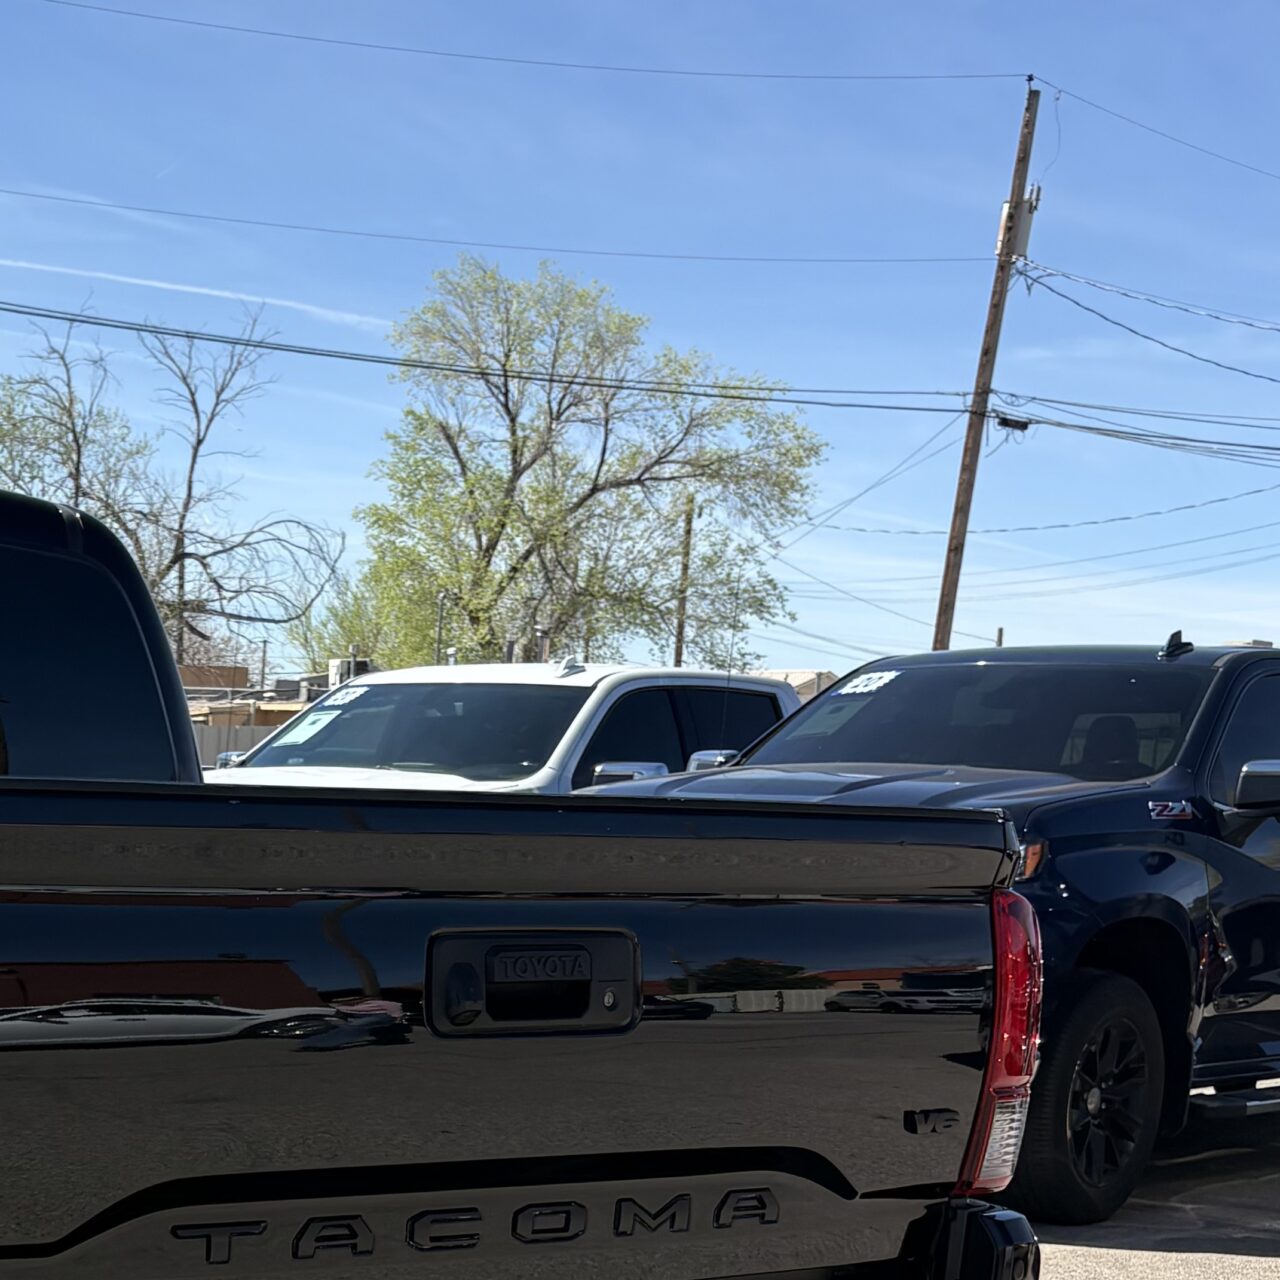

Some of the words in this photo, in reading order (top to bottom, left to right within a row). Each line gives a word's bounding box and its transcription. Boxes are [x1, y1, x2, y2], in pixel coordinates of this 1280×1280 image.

[499, 954, 587, 979] TOYOTA
[910, 1108, 960, 1134] V6
[170, 1187, 781, 1266] TACOMA
